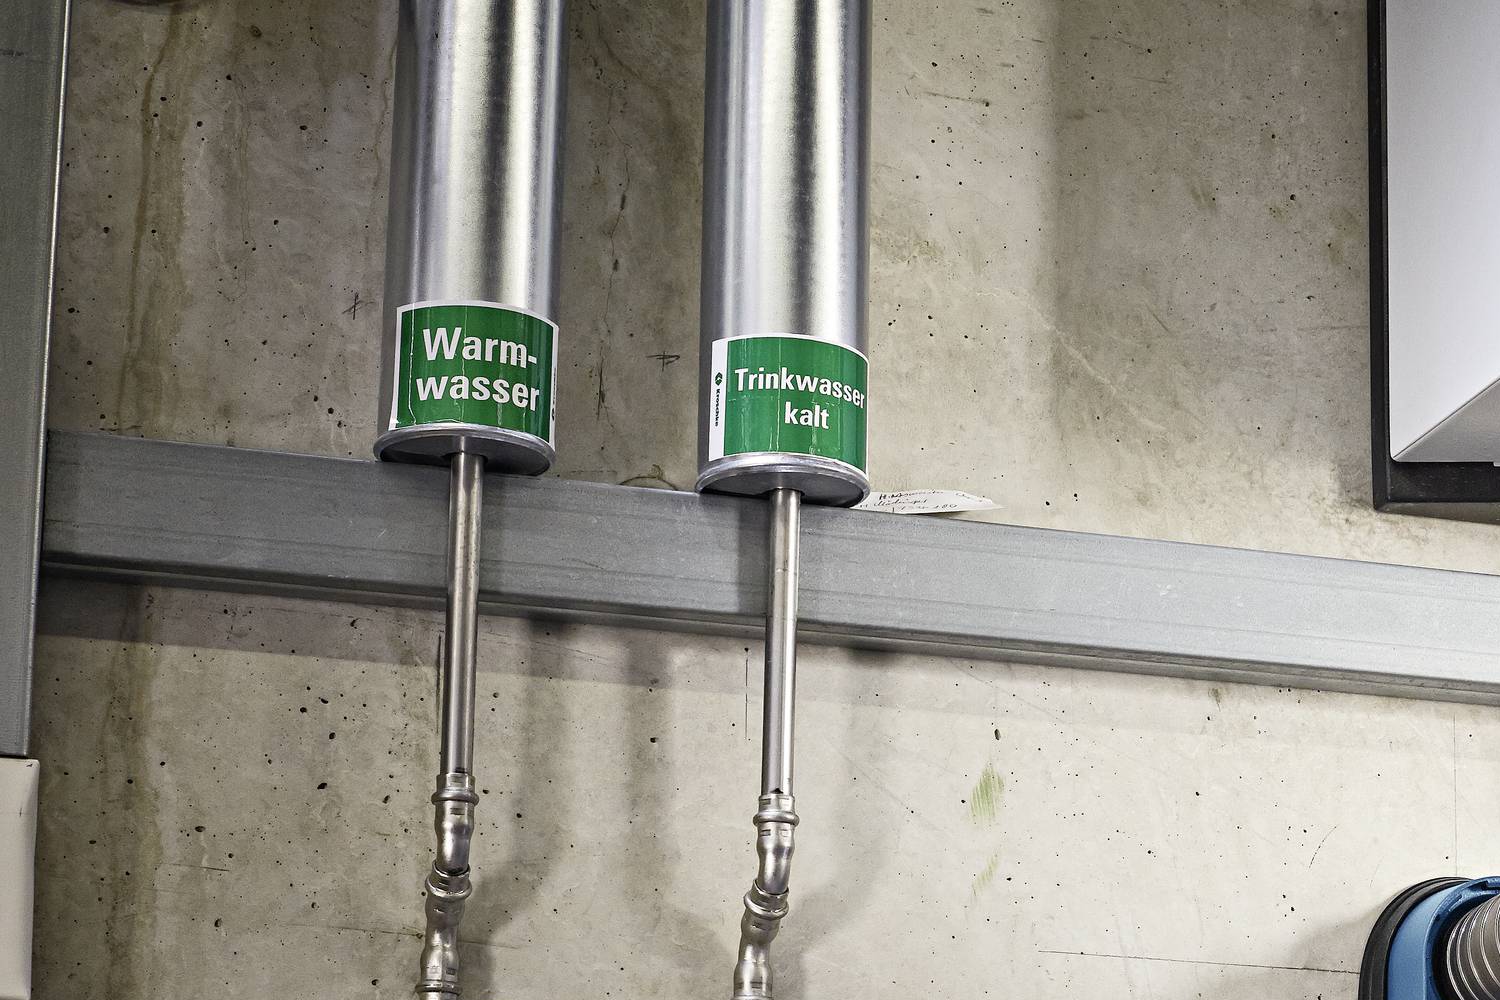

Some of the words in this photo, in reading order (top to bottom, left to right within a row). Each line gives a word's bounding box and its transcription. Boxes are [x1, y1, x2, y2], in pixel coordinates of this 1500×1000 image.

[423, 326, 538, 369] Warm-
[416, 375, 540, 412] wasser
[734, 366, 865, 409] Trinkwasser
[784, 401, 830, 430] kalt
